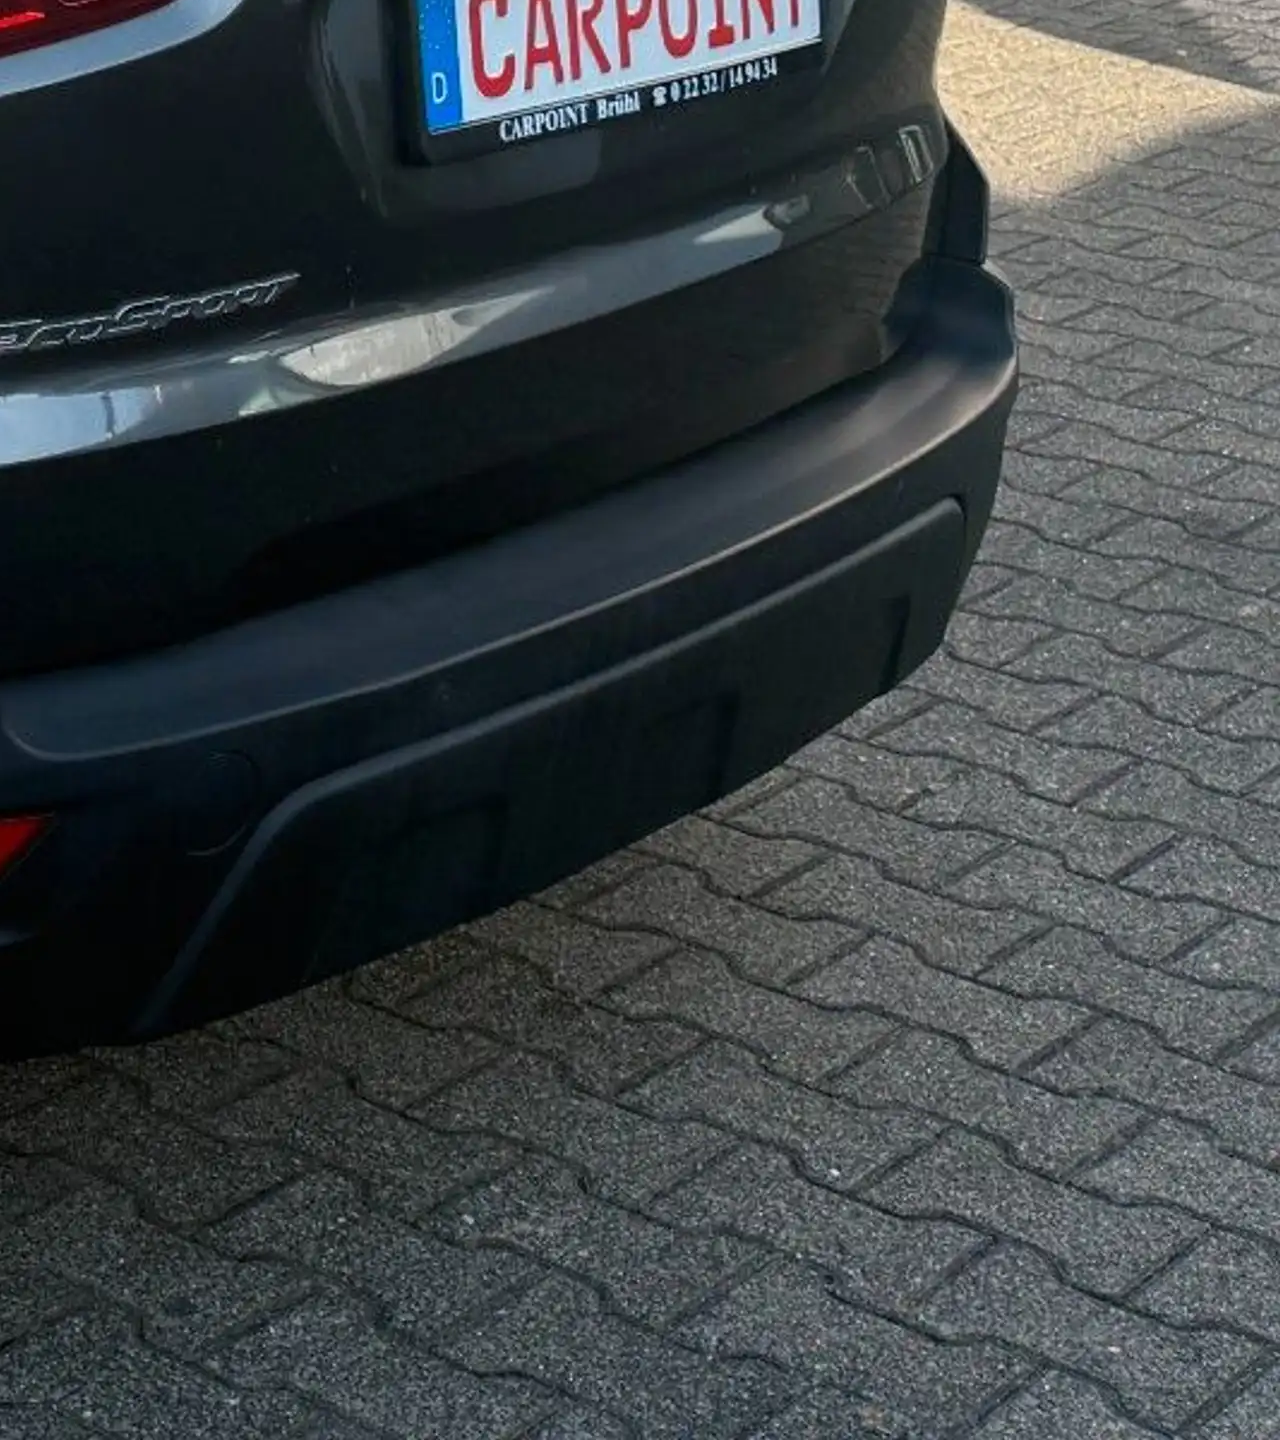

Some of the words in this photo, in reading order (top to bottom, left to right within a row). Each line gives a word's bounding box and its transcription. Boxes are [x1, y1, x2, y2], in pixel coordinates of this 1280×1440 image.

[431, 72, 449, 104] D
[499, 103, 590, 142] CARPOINT
[597, 92, 640, 119] Brühl
